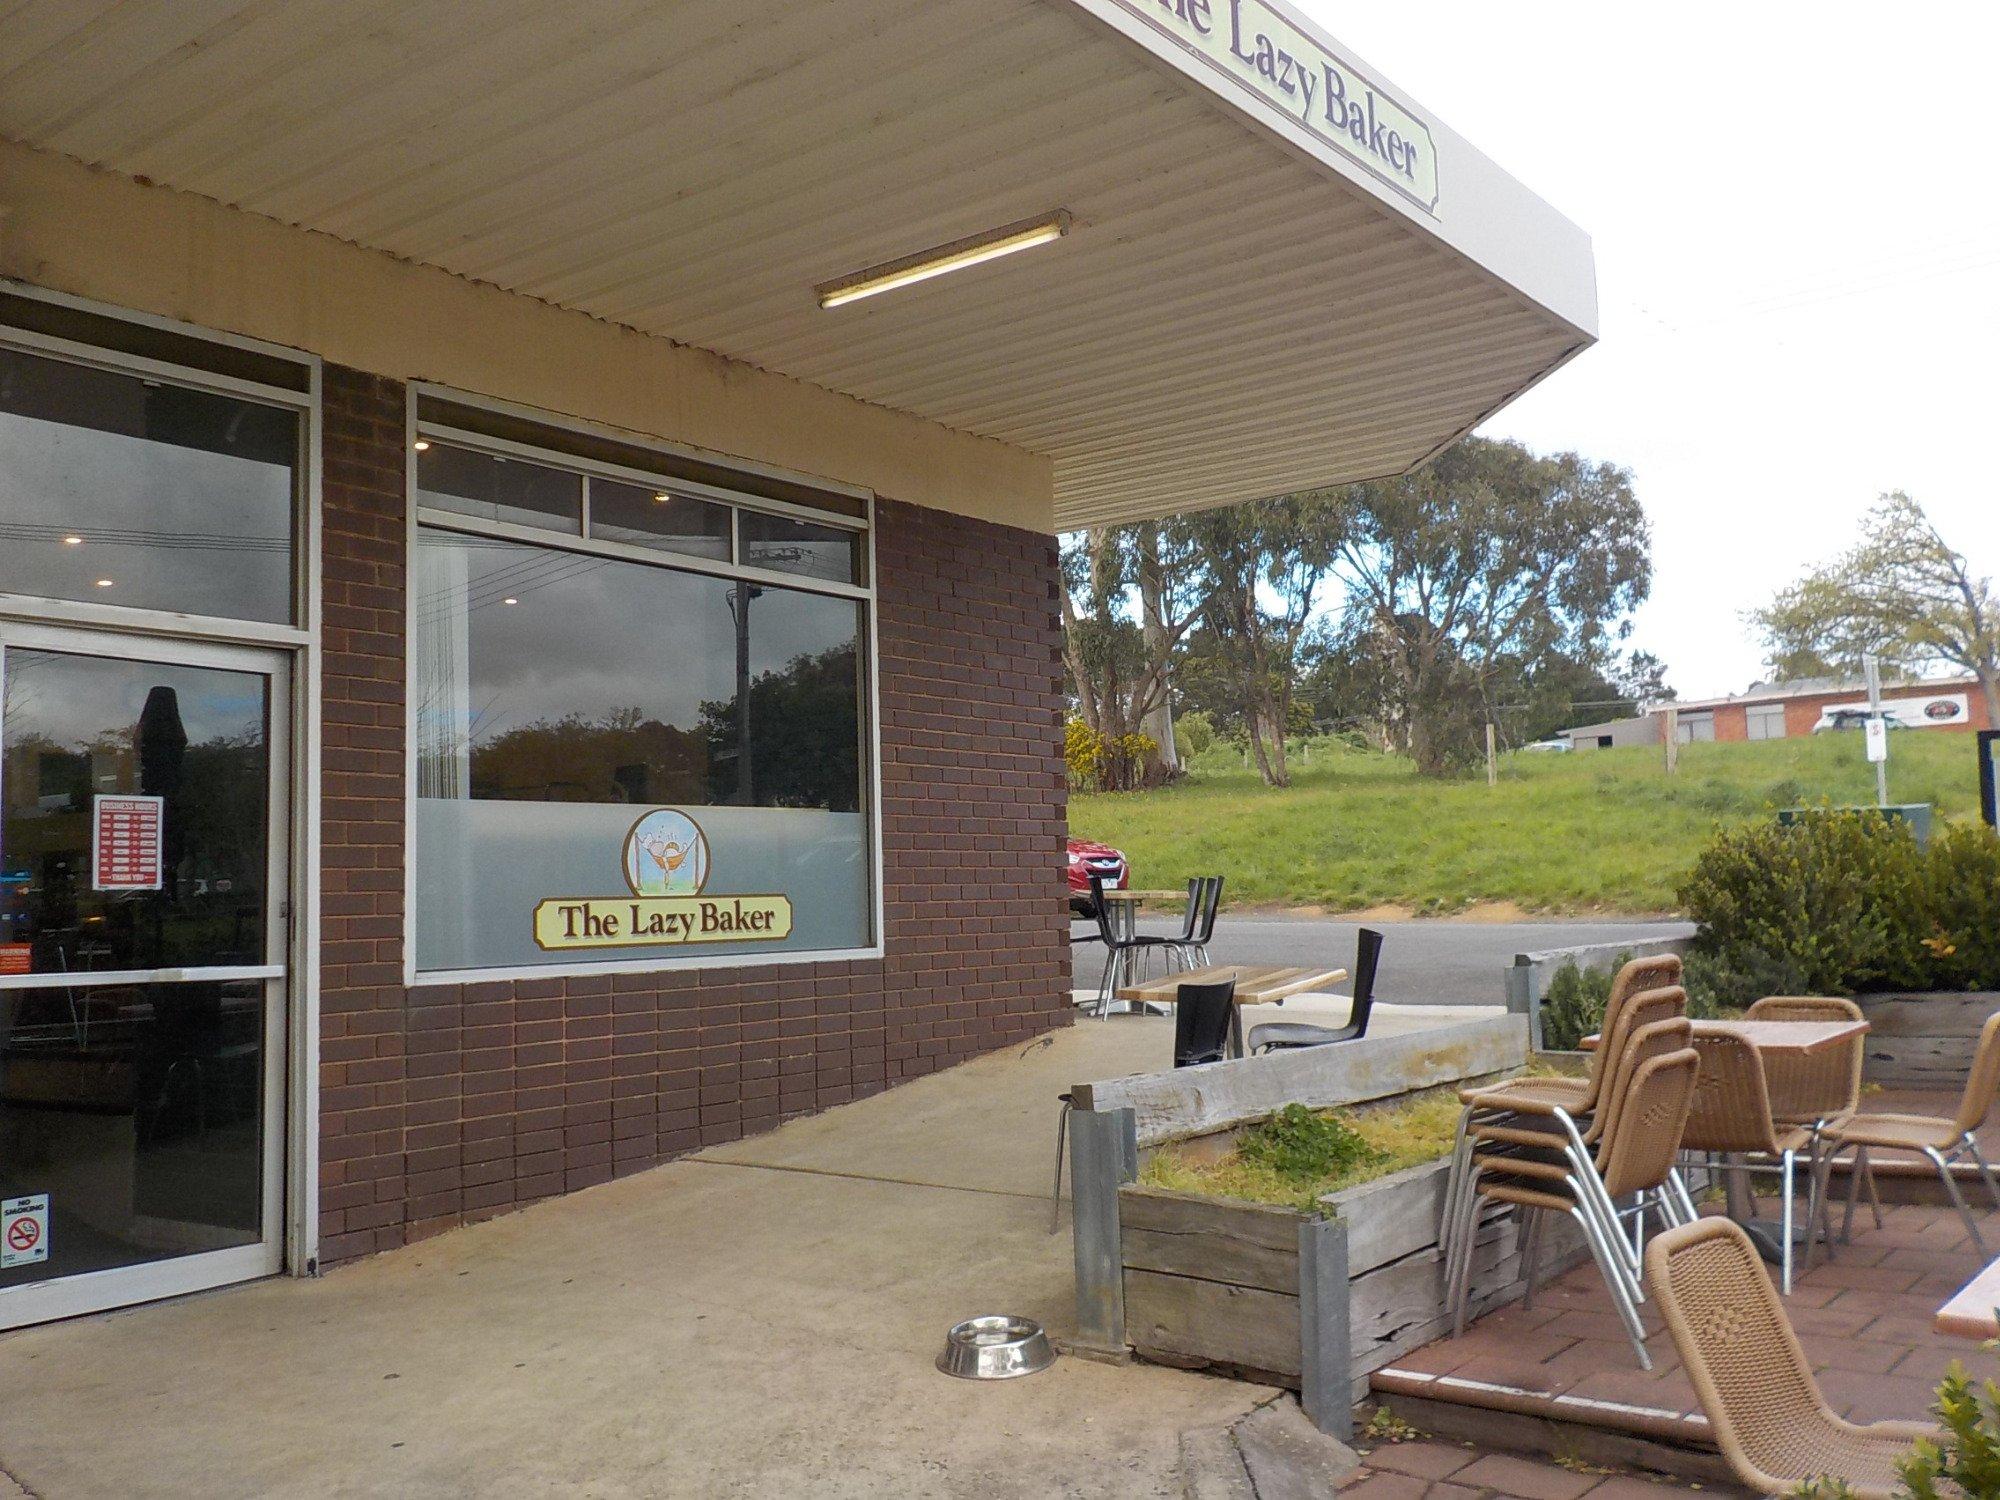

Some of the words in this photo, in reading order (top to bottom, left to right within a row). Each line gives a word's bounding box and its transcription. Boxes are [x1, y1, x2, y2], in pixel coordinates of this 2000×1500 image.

[1230, 0, 1317, 120] Lazy
[1321, 61, 1417, 179] Baker
[558, 903, 618, 938] The
[629, 904, 696, 941] Lazy
[699, 899, 775, 932] Baker
[4, 1203, 45, 1216] SMOKING
